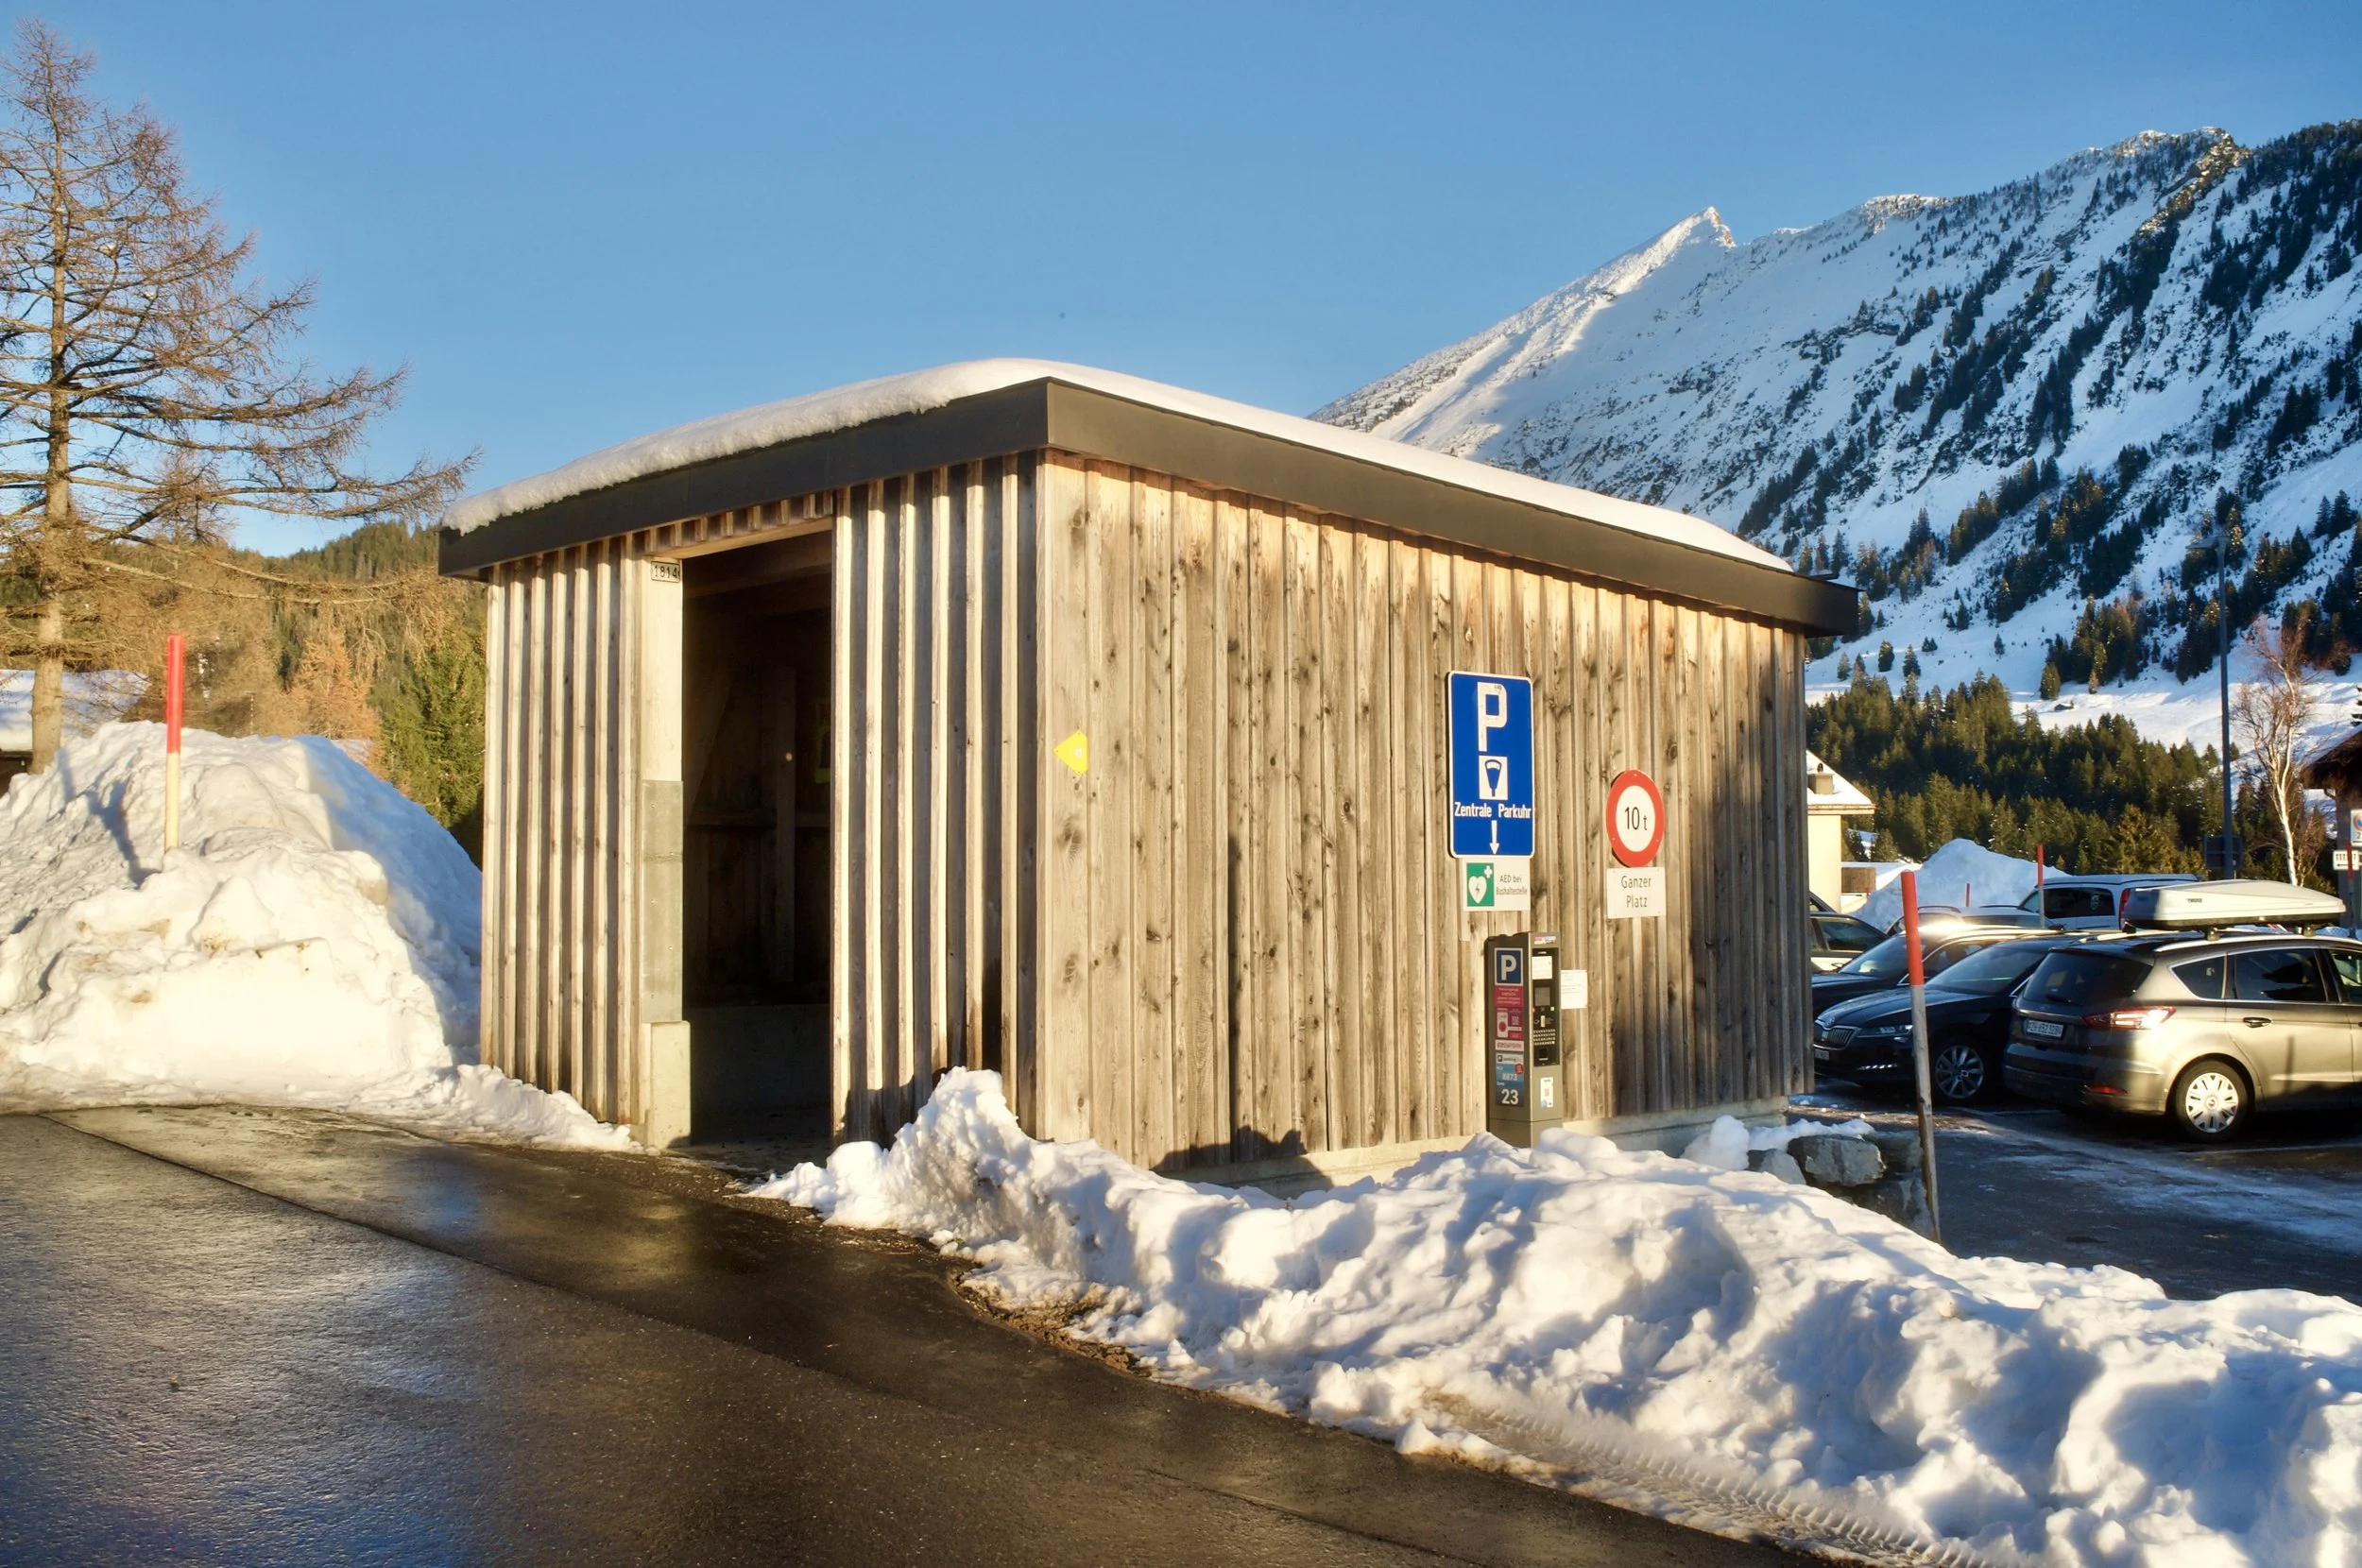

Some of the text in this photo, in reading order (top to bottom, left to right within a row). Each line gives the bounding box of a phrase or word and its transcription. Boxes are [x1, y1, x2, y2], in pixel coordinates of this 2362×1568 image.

[654, 565, 677, 579] 1814
[1477, 682, 1508, 753] P
[1454, 802, 1532, 820] Zentrale Parkuhr
[1624, 806, 1648, 831] 10 t
[1499, 875, 1512, 883] AED
[1620, 875, 1652, 888] Ganzer
[1626, 895, 1648, 909] Platz
[1500, 954, 1517, 980] P
[1500, 1088, 1519, 1105] 23
